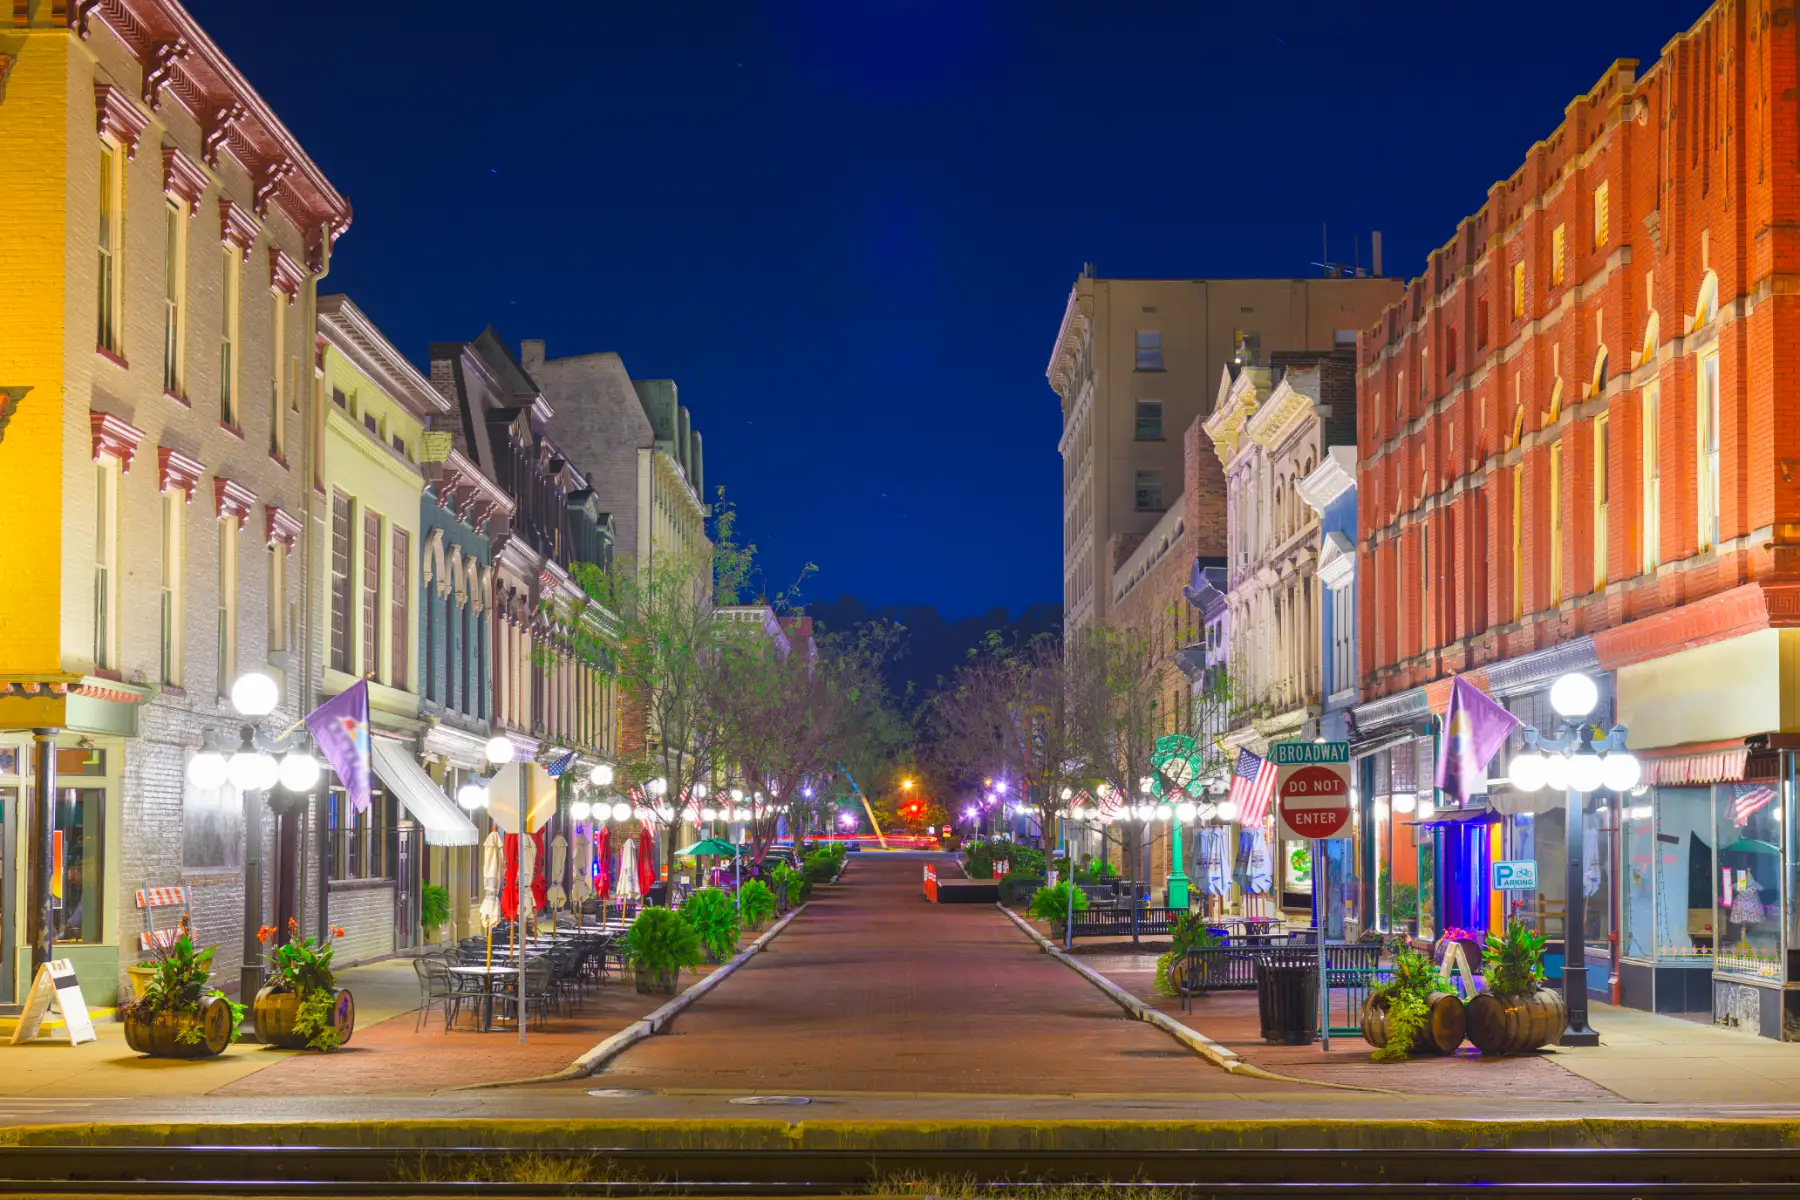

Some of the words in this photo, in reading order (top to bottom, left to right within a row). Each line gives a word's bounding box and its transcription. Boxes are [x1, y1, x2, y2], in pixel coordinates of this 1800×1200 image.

[1279, 745, 1346, 761] BROADWAY
[1290, 781, 1307, 793] DO
[1314, 780, 1340, 791] NOT
[1296, 813, 1336, 824] ENTER
[1496, 866, 1533, 886] PARKING
